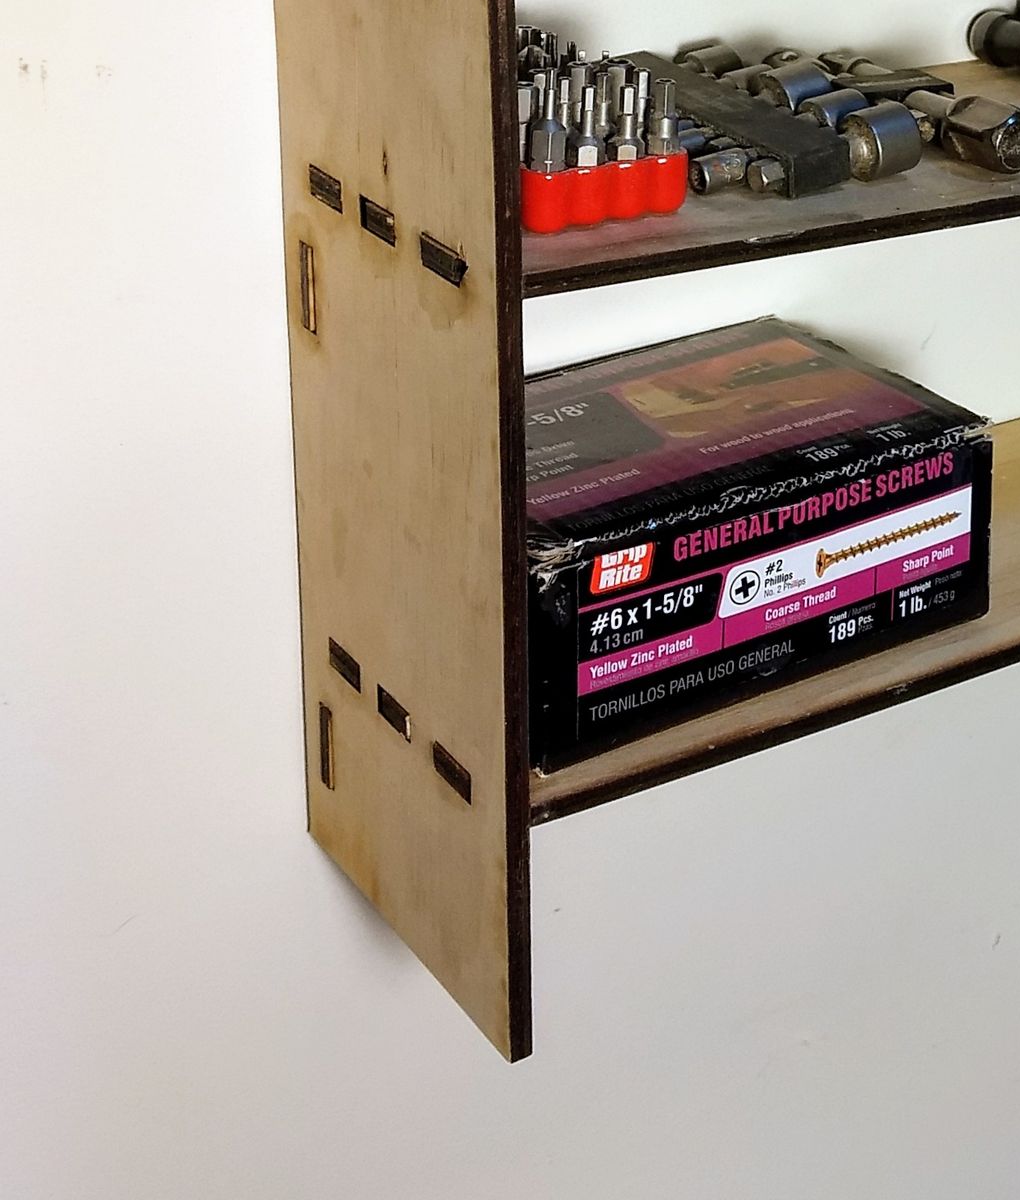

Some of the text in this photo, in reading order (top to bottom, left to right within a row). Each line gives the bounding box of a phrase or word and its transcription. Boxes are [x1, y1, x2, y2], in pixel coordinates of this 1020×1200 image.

[699, 445, 720, 455] For
[721, 435, 750, 448] wood
[750, 432, 763, 441] to
[764, 424, 793, 437] wood
[805, 447, 838, 463] 189
[571, 479, 599, 495] Zinc
[599, 468, 641, 485] Plated
[673, 452, 954, 561] GENERAL PURPOSE SCREWS
[601, 543, 648, 568] Grip
[765, 559, 783, 574] #2
[902, 553, 930, 573] Sharp
[931, 545, 954, 562] Point
[599, 564, 643, 589] Rite
[764, 572, 794, 588] Phillips
[764, 577, 807, 598] No. 2 Phillips
[590, 584, 703, 636] #6 x 1-5/8"
[765, 586, 837, 621] Coarse Thread
[899, 599, 906, 618] 1
[910, 593, 928, 615] lb.
[829, 611, 847, 624] Count
[829, 612, 874, 644] 189 Pcs.
[590, 628, 644, 654] 4.13 cm
[590, 635, 693, 679] Yellow Zinc Plated
[589, 639, 795, 721] TORNILLOS PARA USO GENERAL
